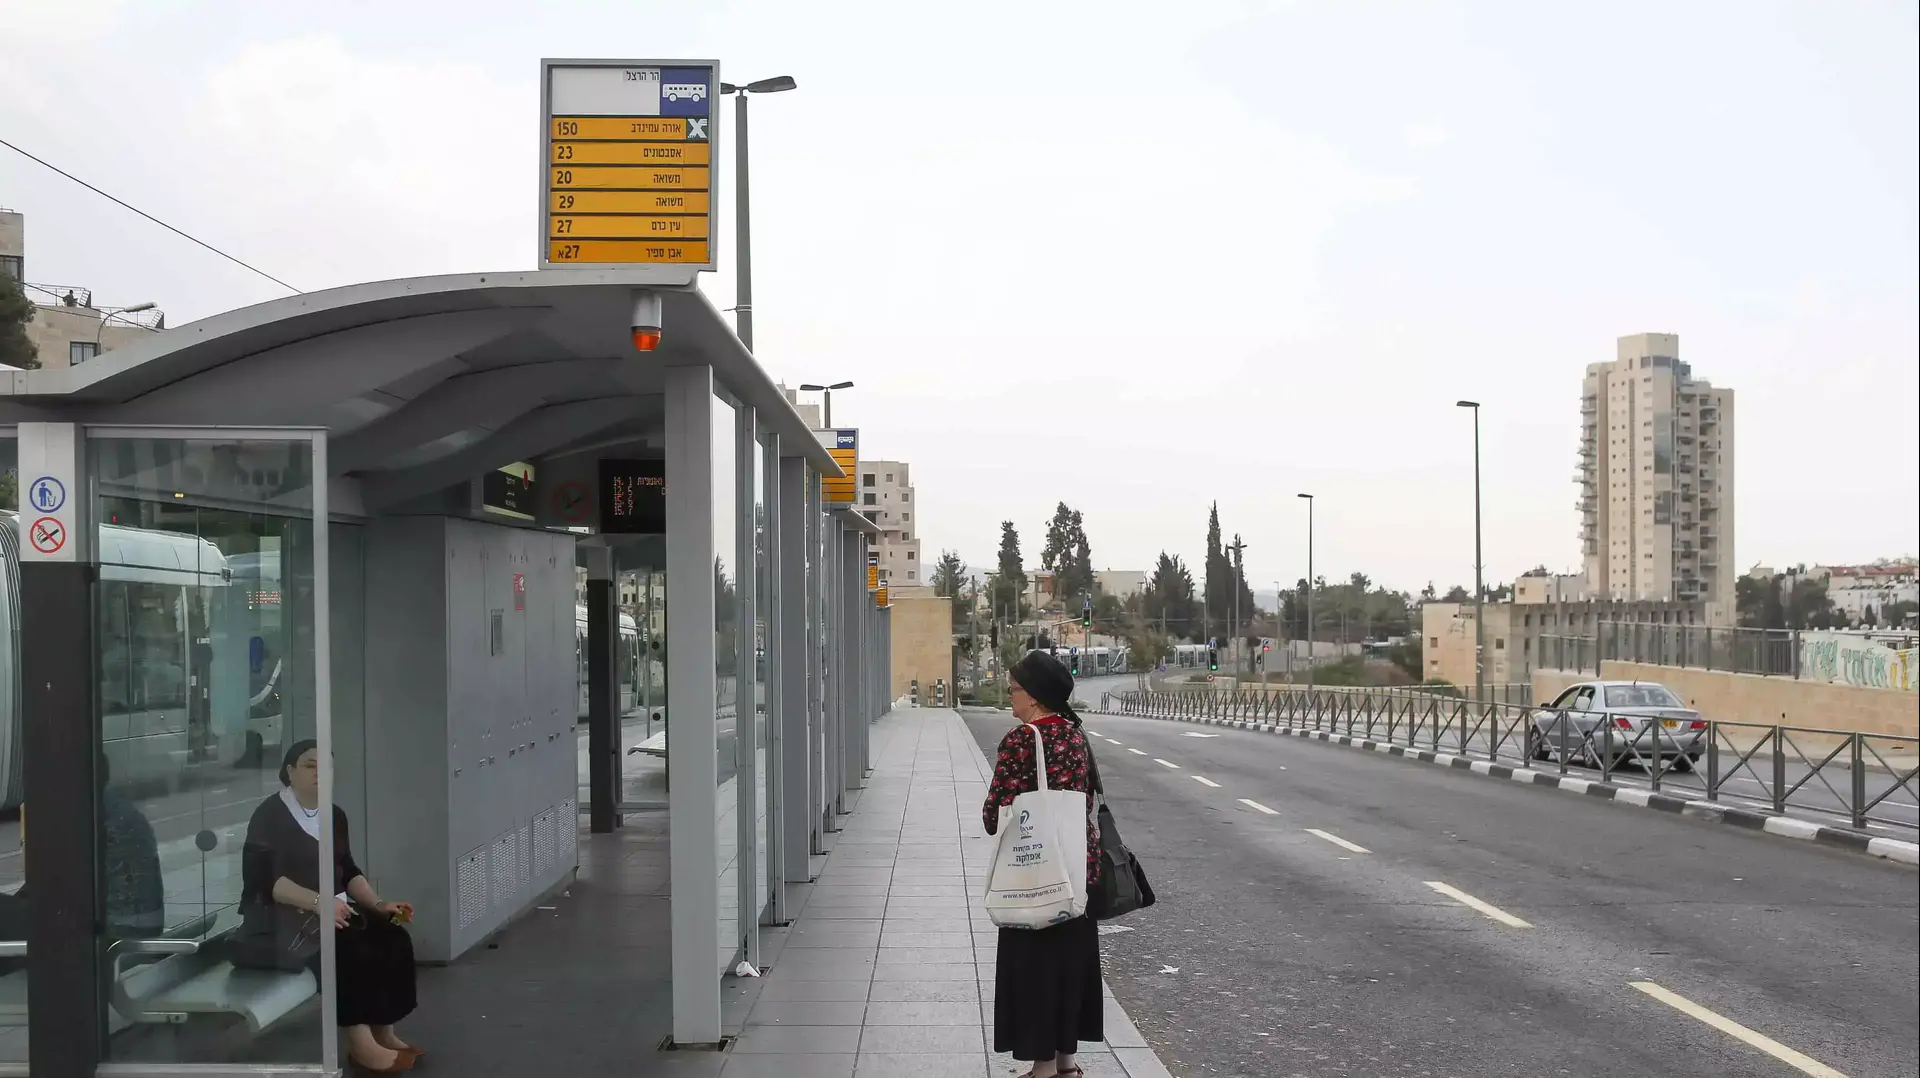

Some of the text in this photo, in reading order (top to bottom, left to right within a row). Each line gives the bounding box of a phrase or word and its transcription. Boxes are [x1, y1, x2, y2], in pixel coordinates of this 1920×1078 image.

[626, 71, 659, 81] הר הרצל
[557, 121, 681, 136] אורה עמינדב 150
[557, 145, 573, 160] 23
[556, 170, 680, 184] משואה 20
[559, 195, 683, 209] משואה 29
[557, 219, 681, 233] עין כרם 27
[645, 248, 664, 258] ספיר
[668, 248, 682, 259] אבן
